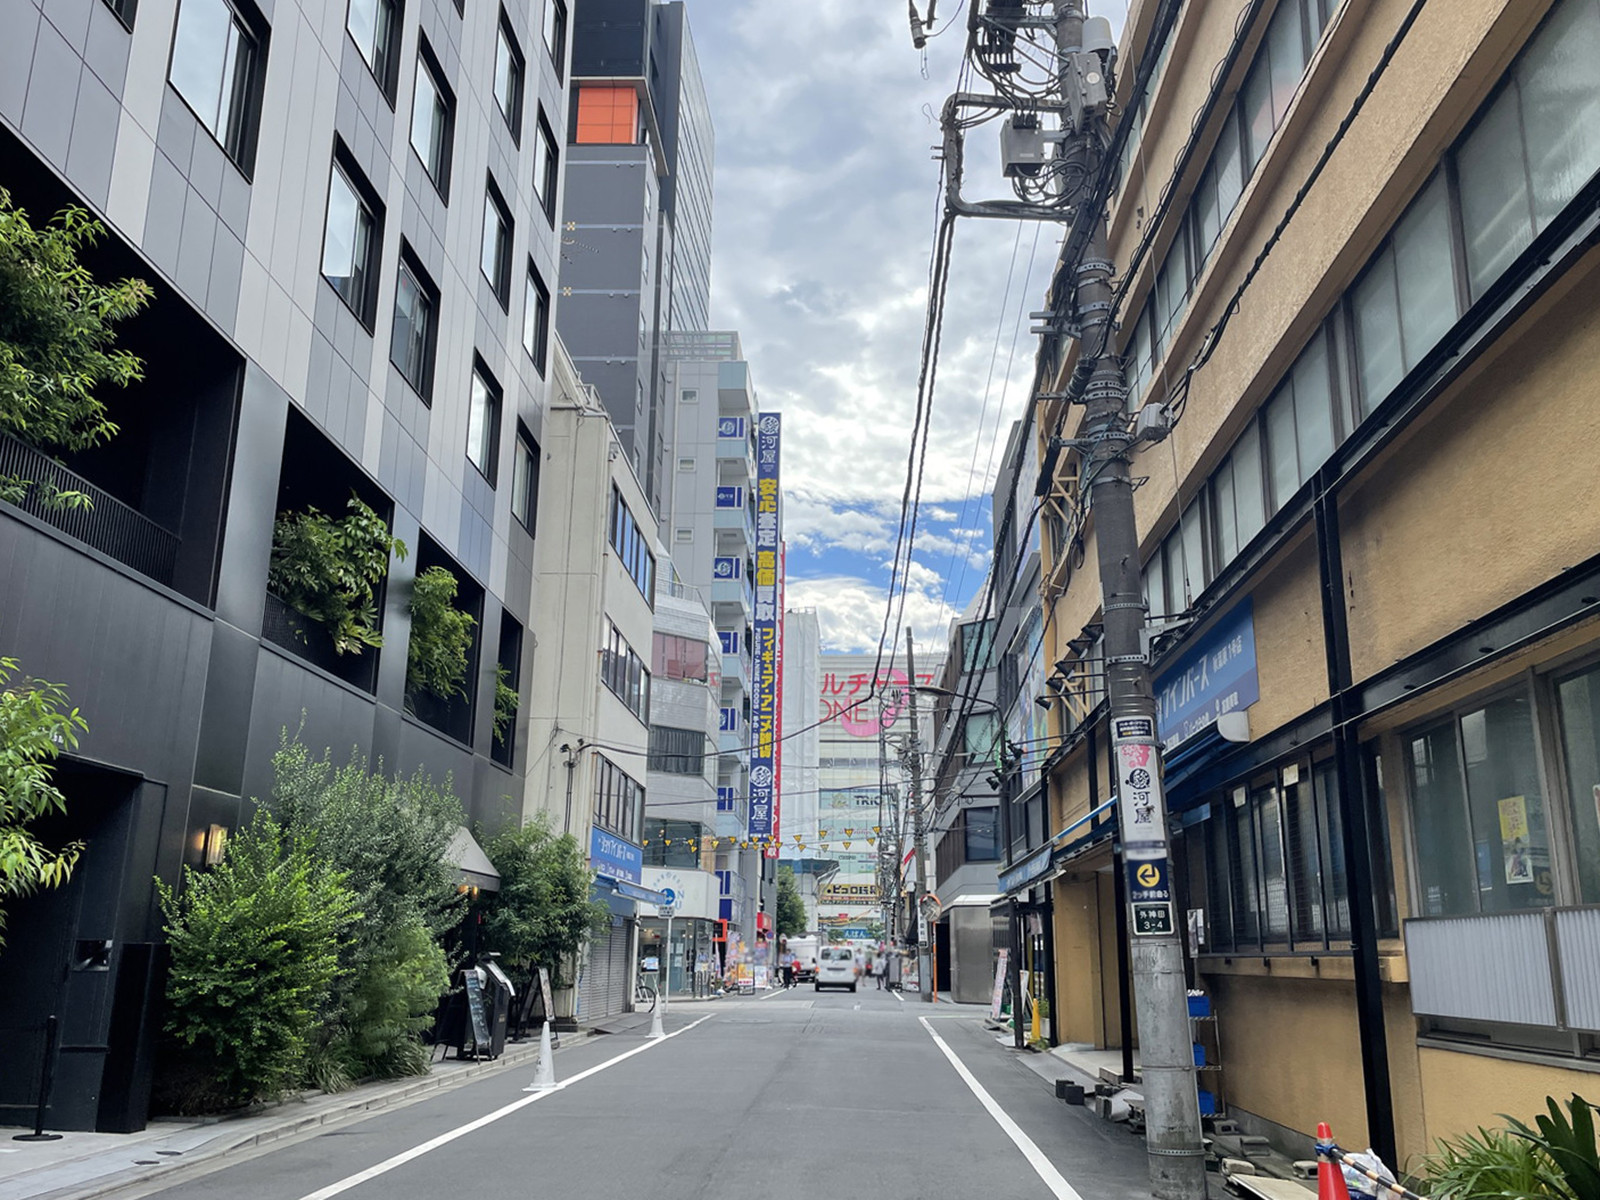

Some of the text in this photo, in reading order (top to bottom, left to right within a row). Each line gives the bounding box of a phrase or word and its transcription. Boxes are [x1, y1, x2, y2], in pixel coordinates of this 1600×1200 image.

[750, 765, 772, 820] 駿河屋
[1125, 768, 1151, 824] 駿河屋
[1139, 910, 1165, 919] 外神田
[1144, 921, 1163, 930] 3-4
